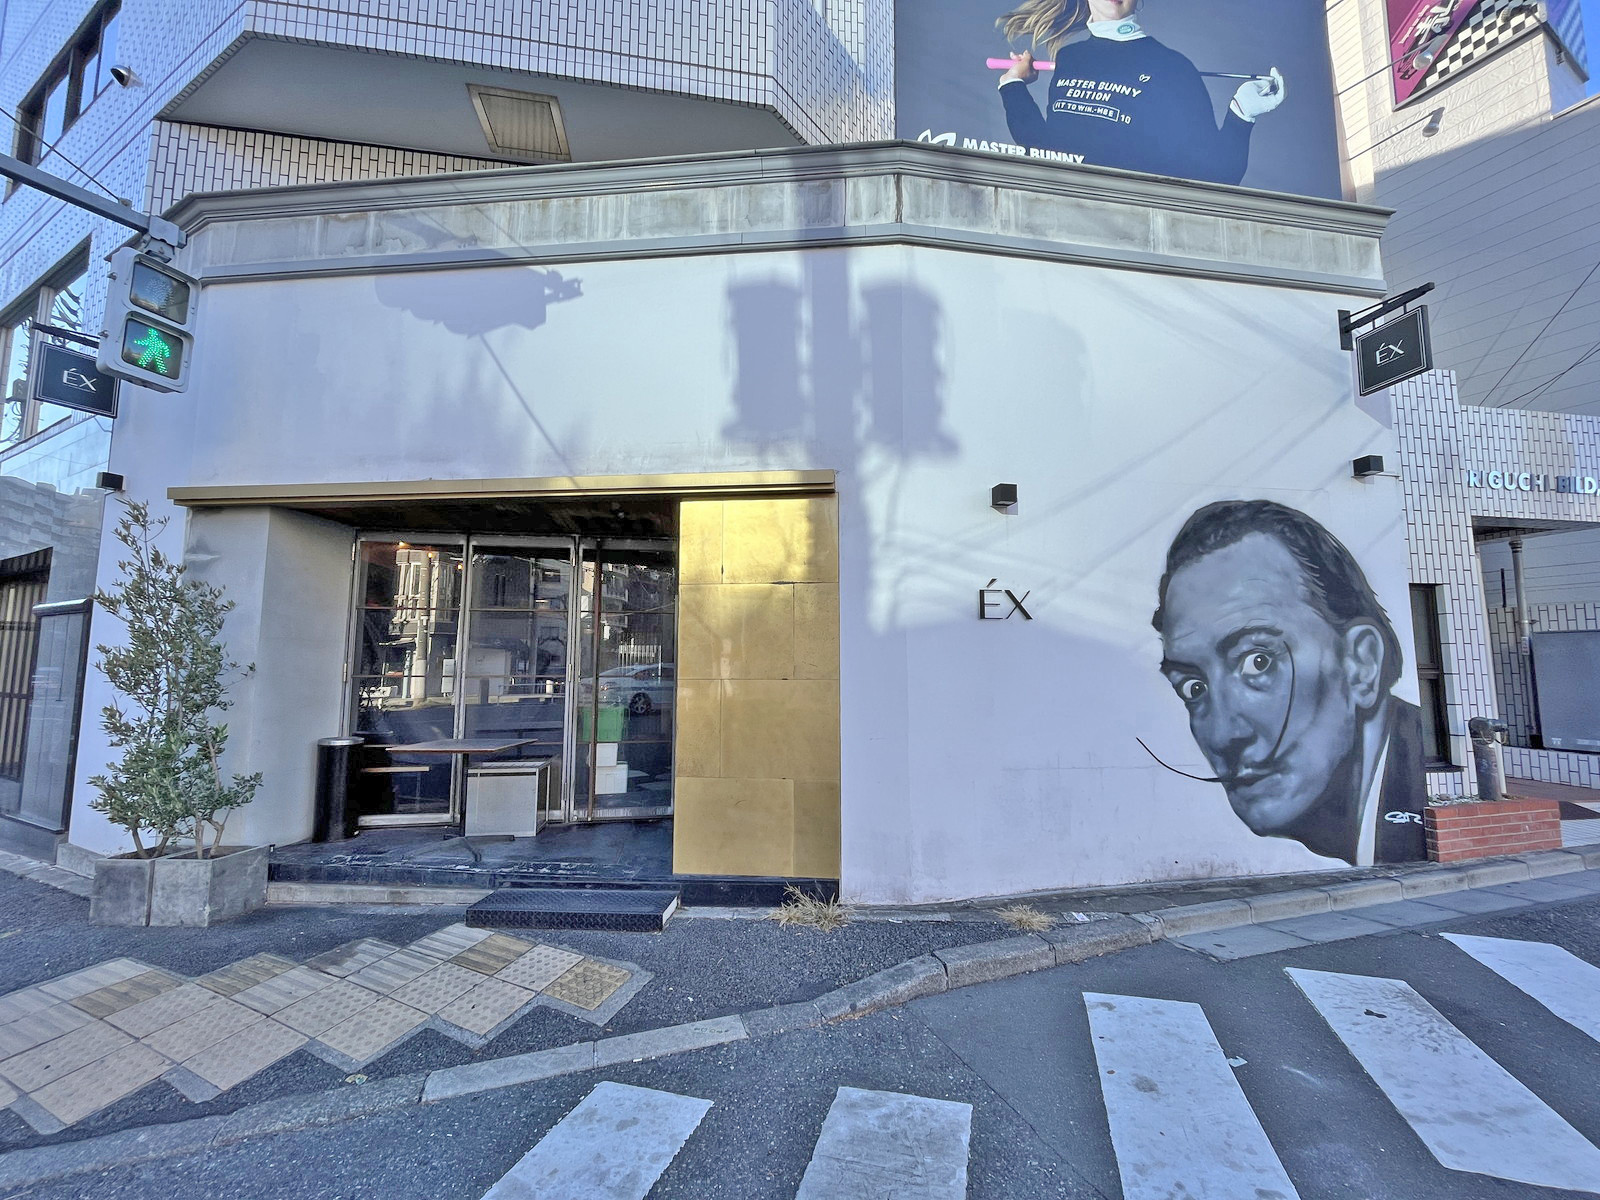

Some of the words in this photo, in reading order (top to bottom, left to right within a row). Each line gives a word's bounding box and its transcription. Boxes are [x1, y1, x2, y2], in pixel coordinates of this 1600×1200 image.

[1056, 79, 1096, 89] MASTER
[1097, 81, 1142, 98] BUNNY
[1066, 88, 1111, 101] EDITION
[1120, 114, 1131, 124] 10
[963, 138, 1026, 157] MASTER
[1030, 148, 1085, 164] BUNNY
[1375, 339, 1405, 365] ÉX
[63, 367, 97, 391] ÉX
[979, 578, 1033, 620] ÉX
